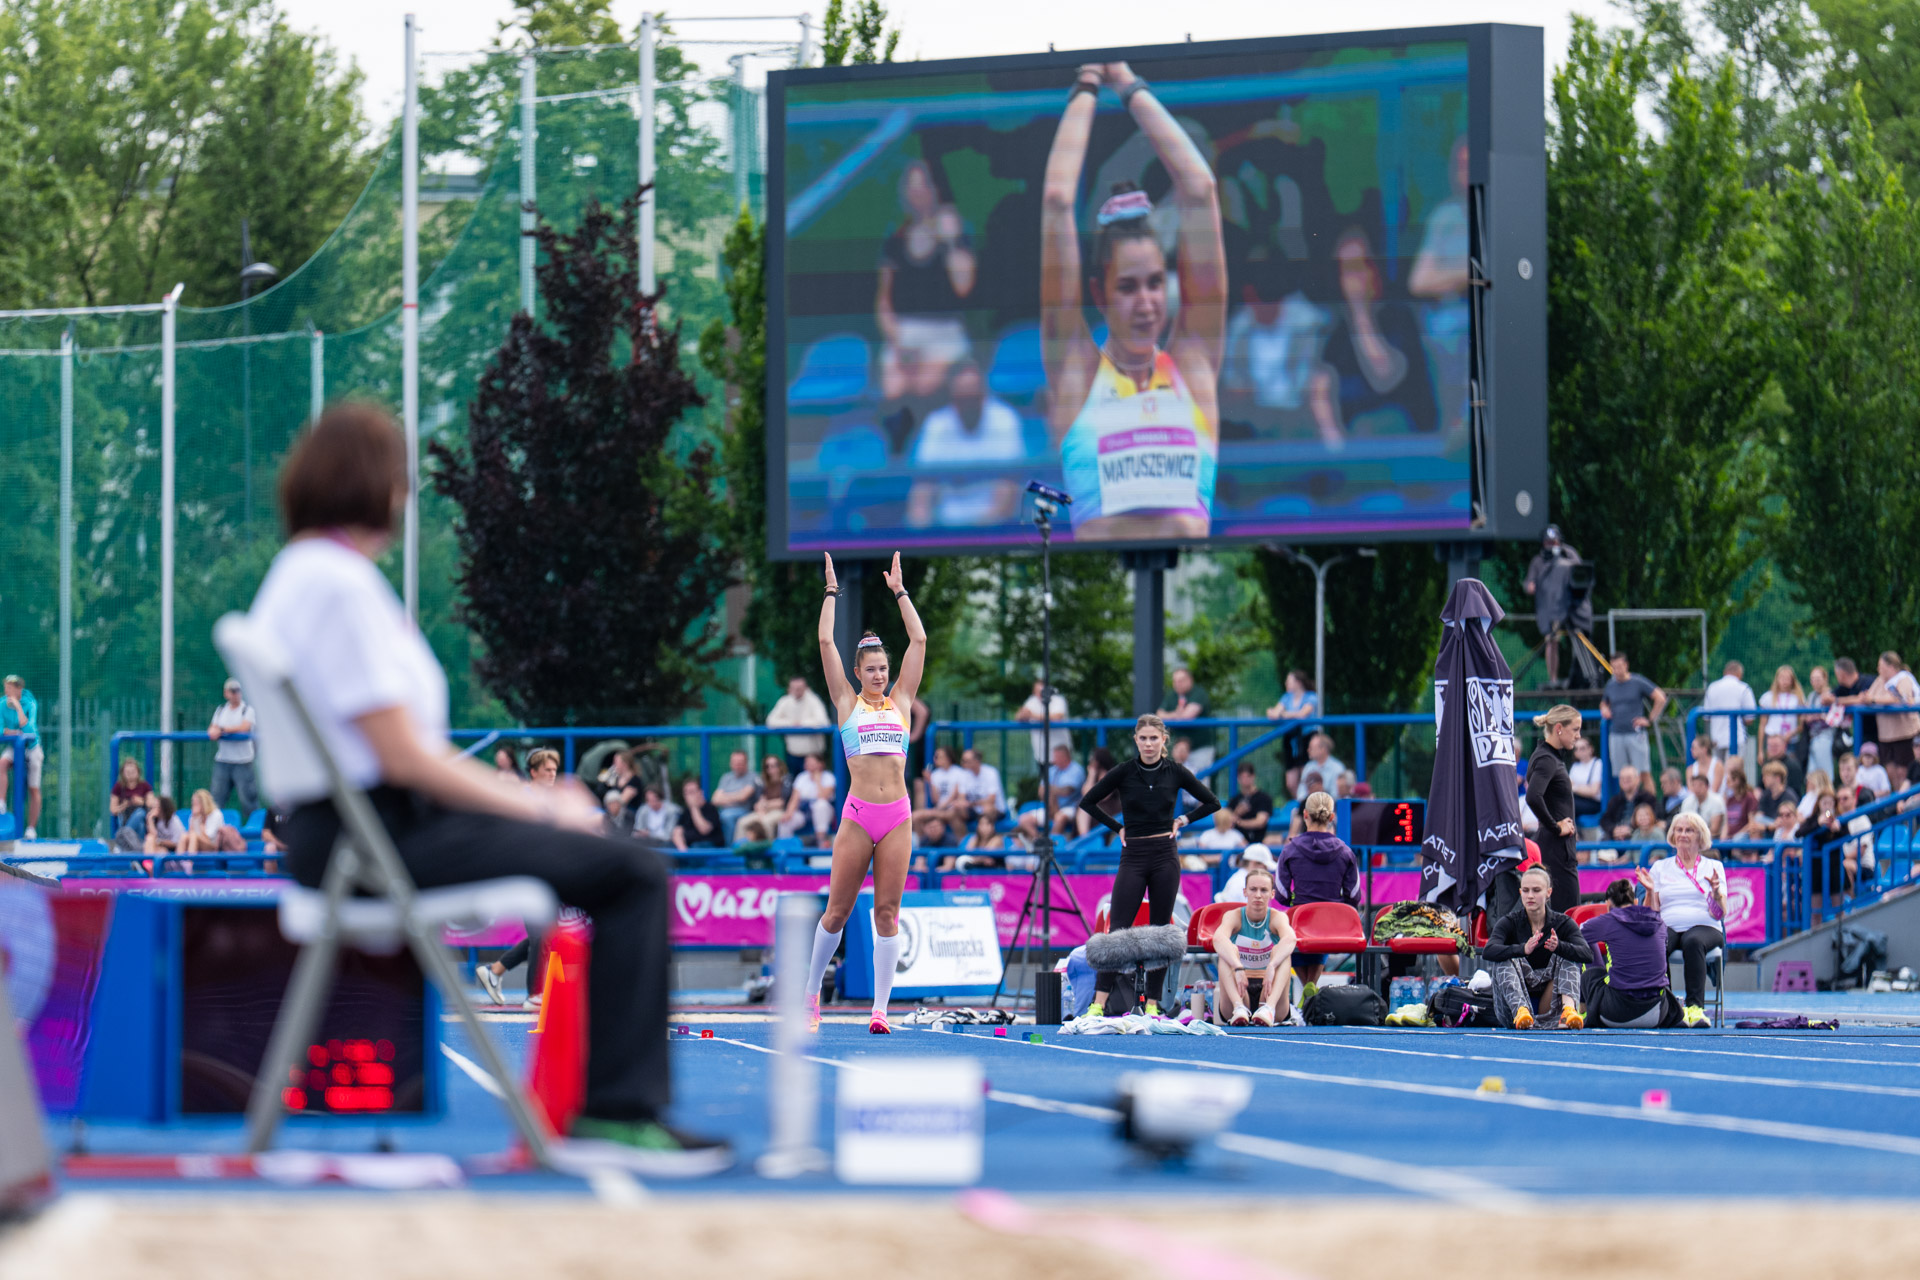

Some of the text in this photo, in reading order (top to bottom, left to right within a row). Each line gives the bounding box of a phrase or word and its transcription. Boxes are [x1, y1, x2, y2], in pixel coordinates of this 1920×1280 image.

[1103, 454, 1195, 484] MATUSZEWICZ
[860, 732, 902, 743] MATUSZEWICZ
[1394, 803, 1413, 842] 3
[675, 882, 779, 927] Mazo
